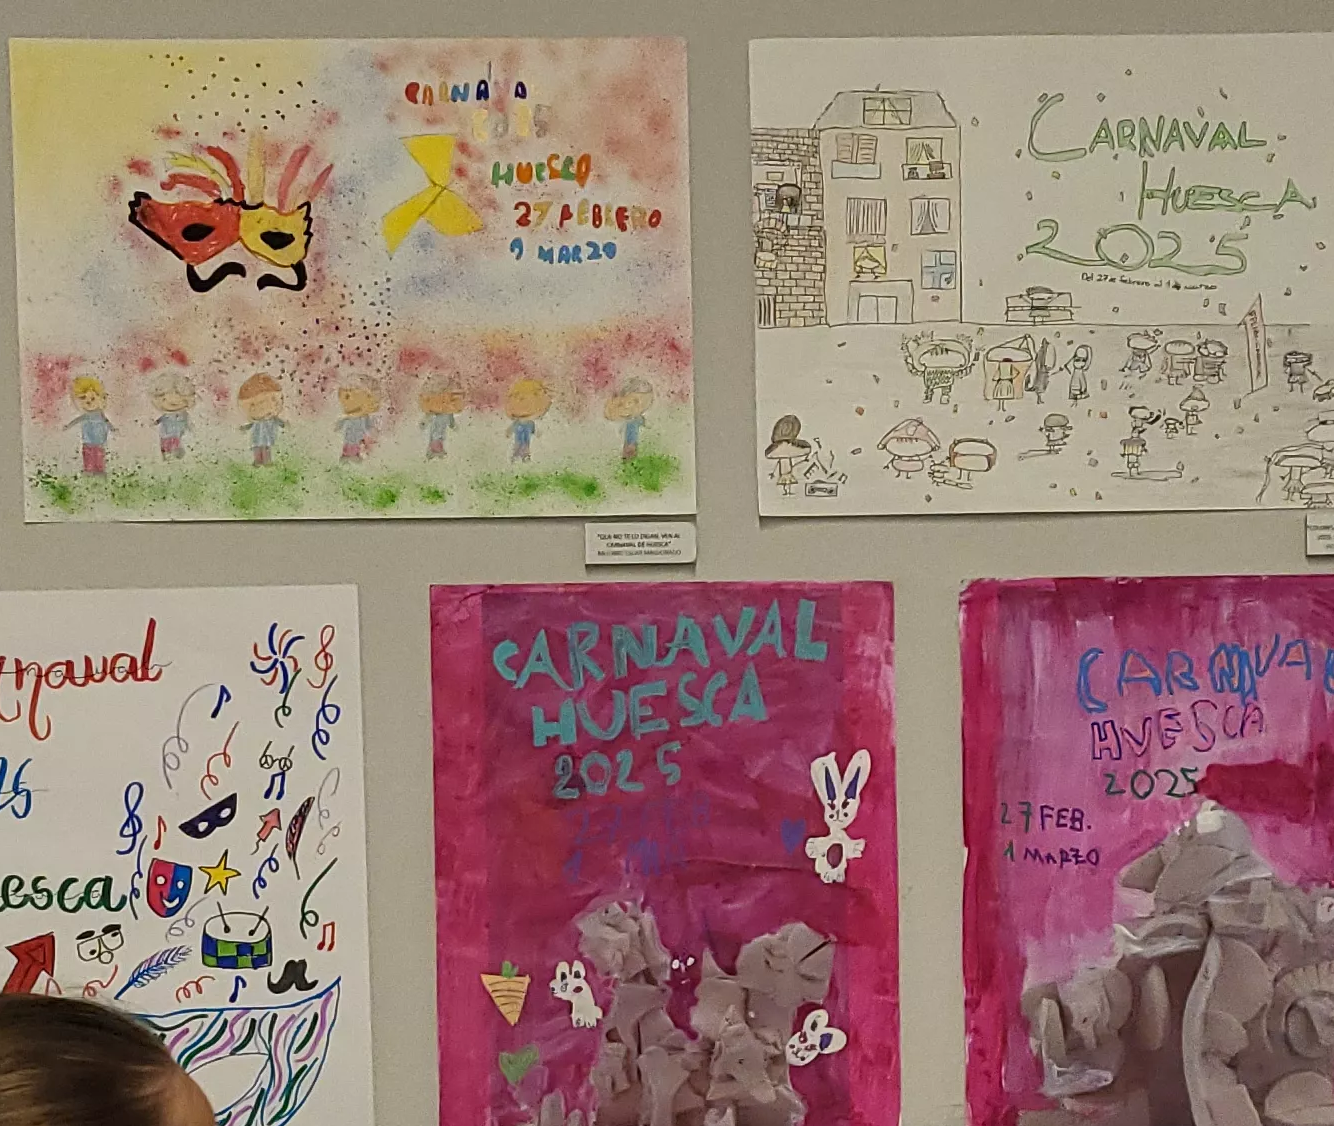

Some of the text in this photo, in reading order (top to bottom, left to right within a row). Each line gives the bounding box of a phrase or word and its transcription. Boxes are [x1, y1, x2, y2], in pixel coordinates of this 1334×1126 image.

[1026, 218, 1250, 277] 2025
[492, 600, 828, 690] CARNAVAL
[531, 661, 769, 748] HUESCA
[552, 740, 683, 799] 2025
[1104, 767, 1200, 800] 2025
[1001, 801, 1033, 834] 27
